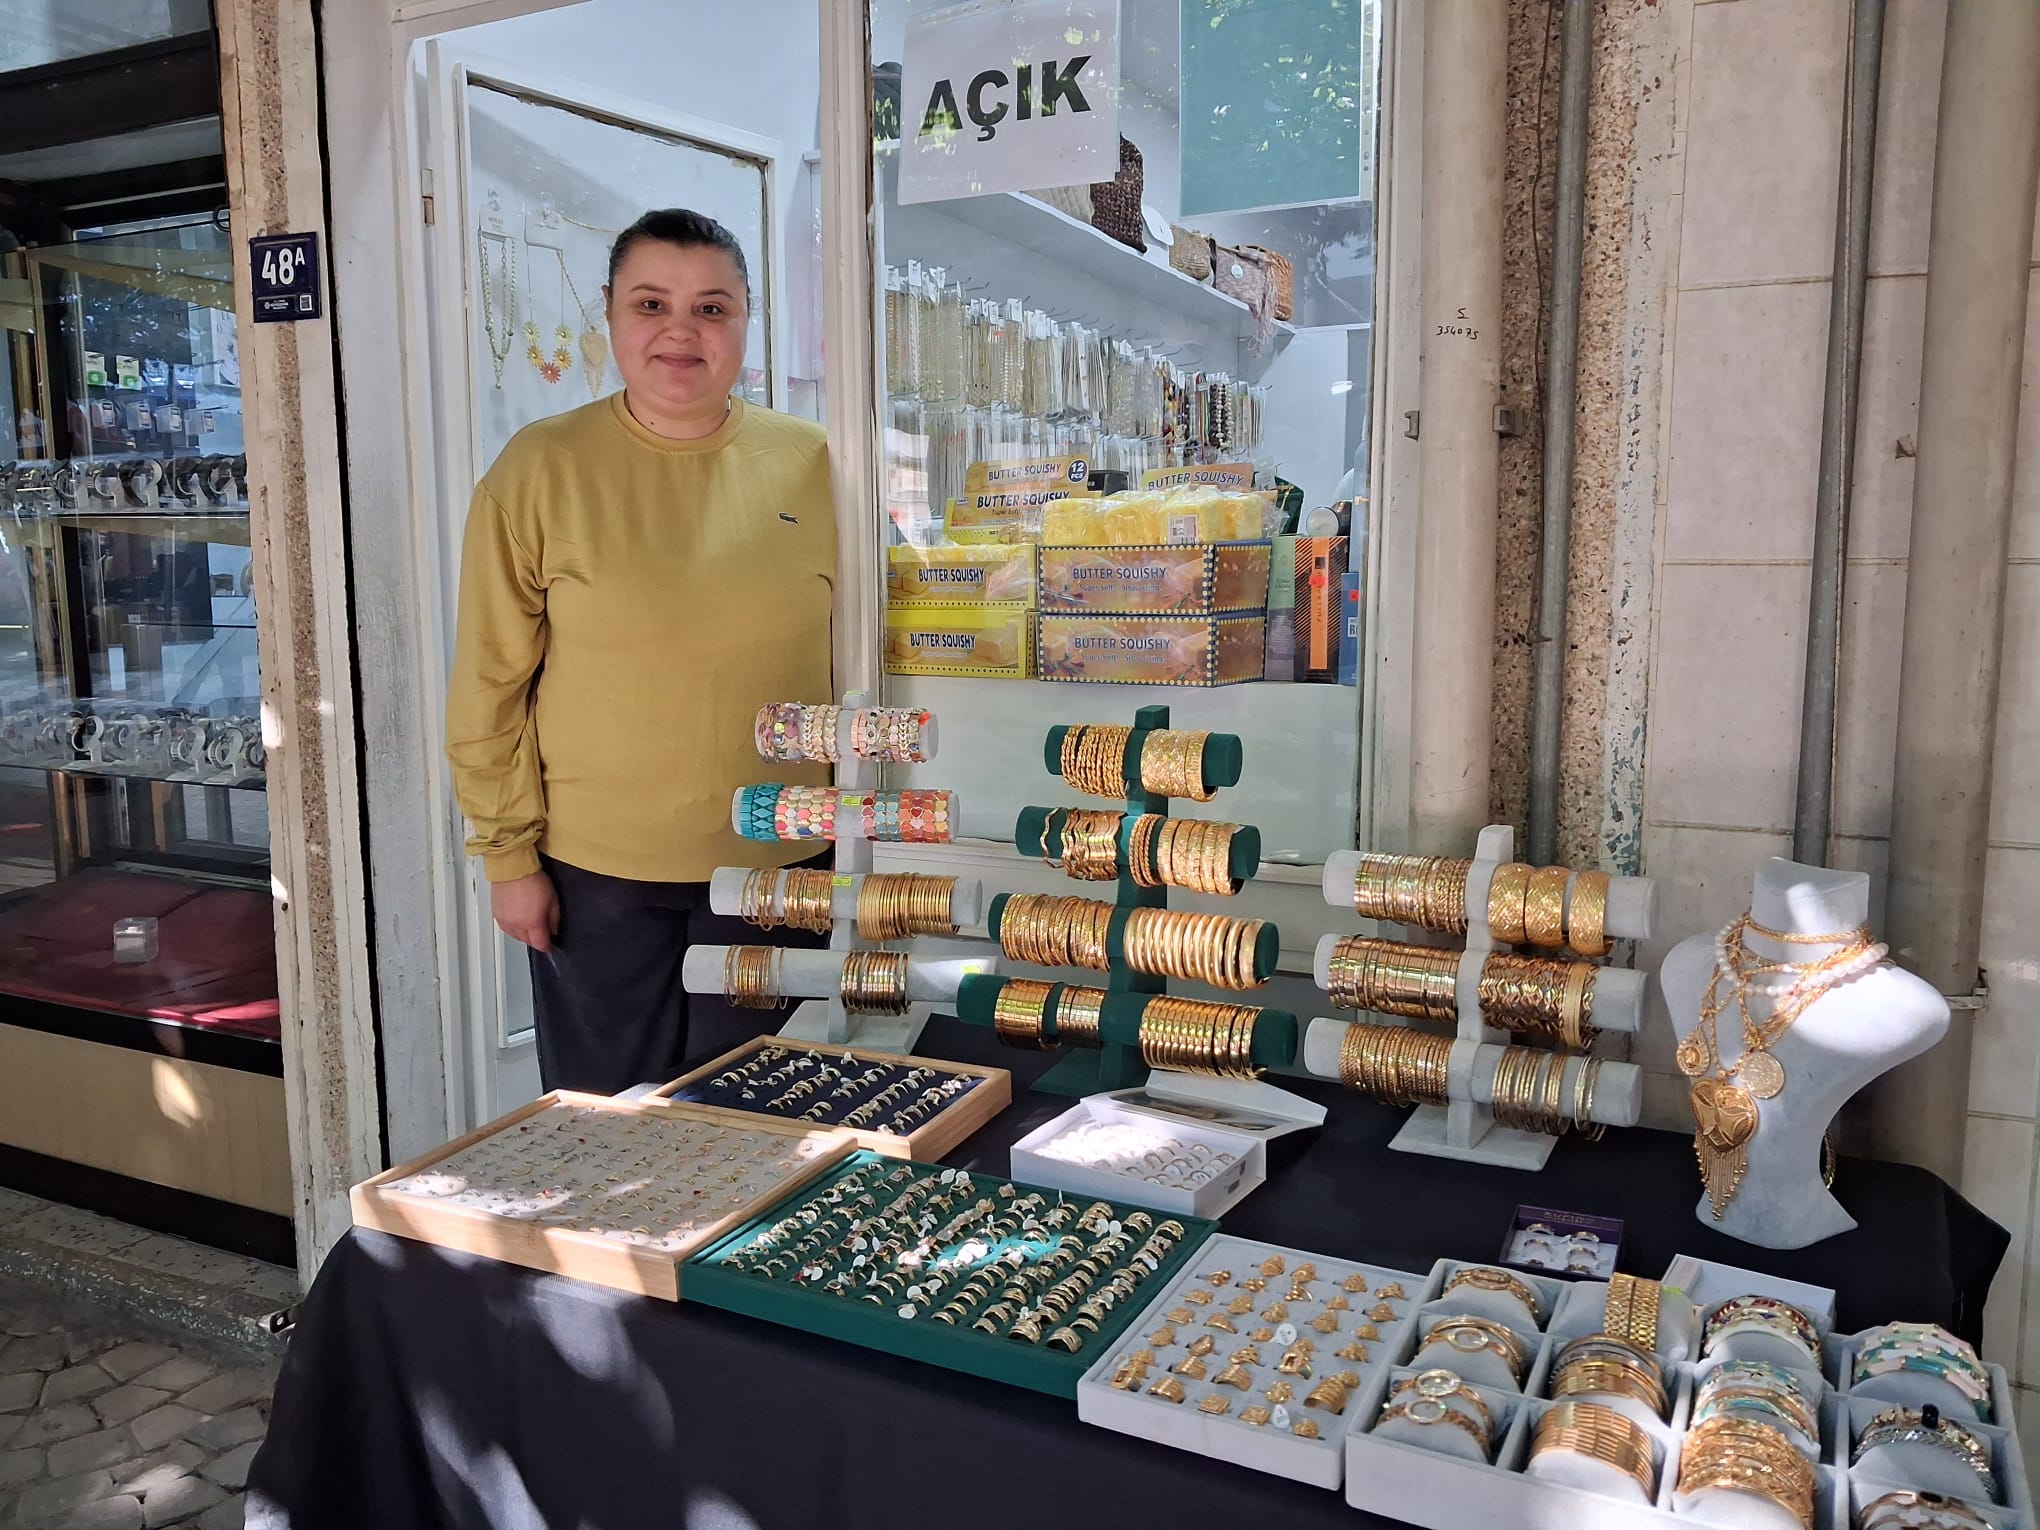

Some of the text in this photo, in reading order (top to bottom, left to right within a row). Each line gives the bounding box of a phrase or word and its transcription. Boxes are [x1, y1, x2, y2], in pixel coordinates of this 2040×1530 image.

[919, 55, 1093, 142] AÇIK
[988, 463, 1062, 481] BUTTER SQUISHY
[1071, 461, 1084, 473] 12
[1148, 471, 1244, 491] BUTTER SQUISHY
[977, 494, 1020, 509] BUTTER
[918, 568, 985, 583] BUTTER SQUISHY
[1073, 567, 1167, 579] BUTTER SQUISHY
[910, 633, 976, 648] BUTTER SQUISHY
[1074, 637, 1171, 650] BUTTER SQUISHY
